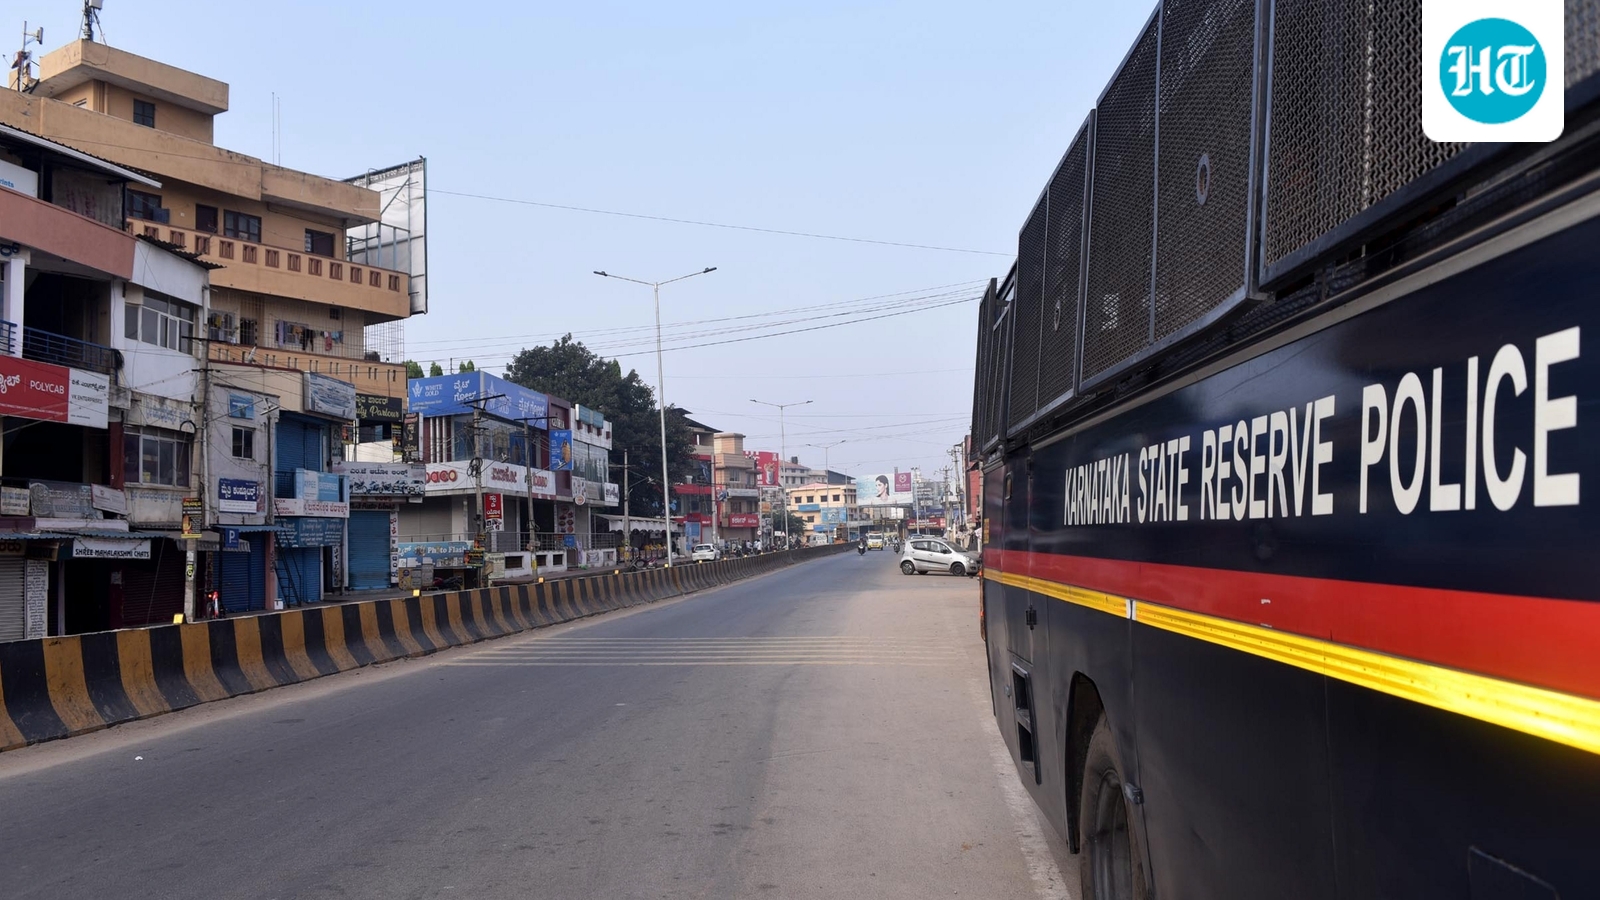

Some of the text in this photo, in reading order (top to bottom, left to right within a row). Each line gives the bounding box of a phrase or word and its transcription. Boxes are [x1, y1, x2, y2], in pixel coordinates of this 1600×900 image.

[30, 380, 65, 395] POLYCAB
[425, 383, 442, 391] WHITE
[370, 405, 399, 418] Parlour
[1064, 326, 1580, 526] KARNATAKA STATE RESERVE POLICE
[229, 530, 236, 543] P
[75, 548, 150, 558] SHREE MAHALAKSHMI CHATS
[427, 545, 466, 554] Photo Flash
